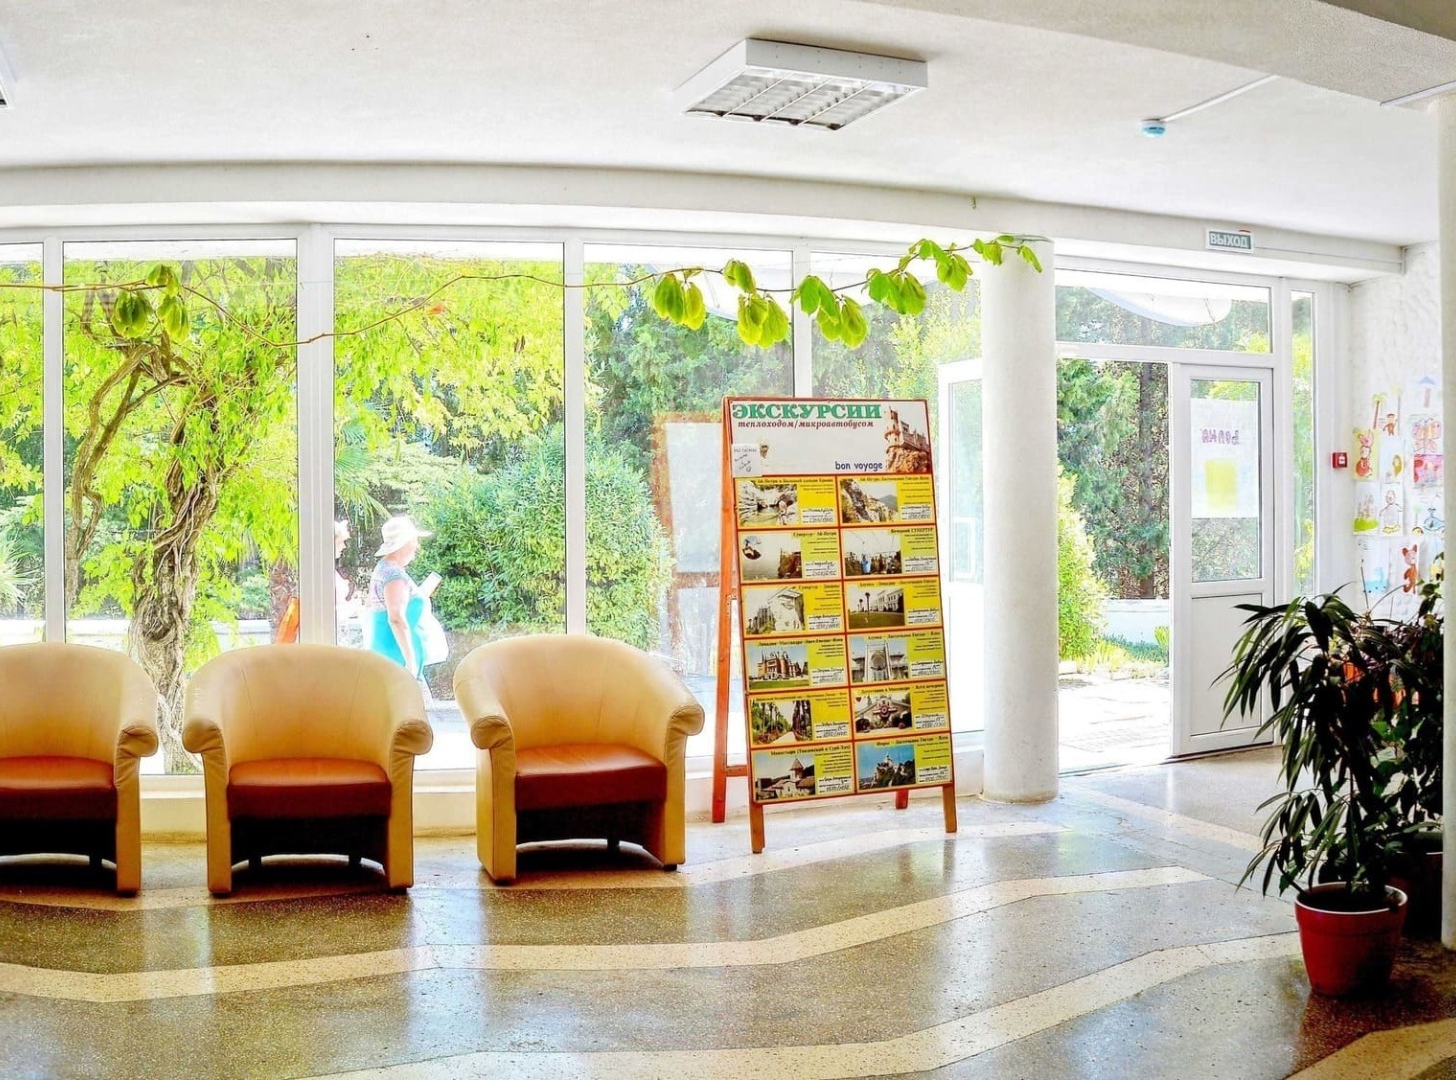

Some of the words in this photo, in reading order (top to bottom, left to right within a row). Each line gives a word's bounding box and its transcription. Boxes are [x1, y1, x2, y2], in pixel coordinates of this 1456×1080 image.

[1210, 233, 1249, 248] ВЫХОД
[732, 403, 883, 419] ЭКСКУРСИИ
[738, 420, 874, 430] теплоходом/микроавтобусом
[835, 461, 851, 470] bon
[853, 462, 883, 472] voyage
